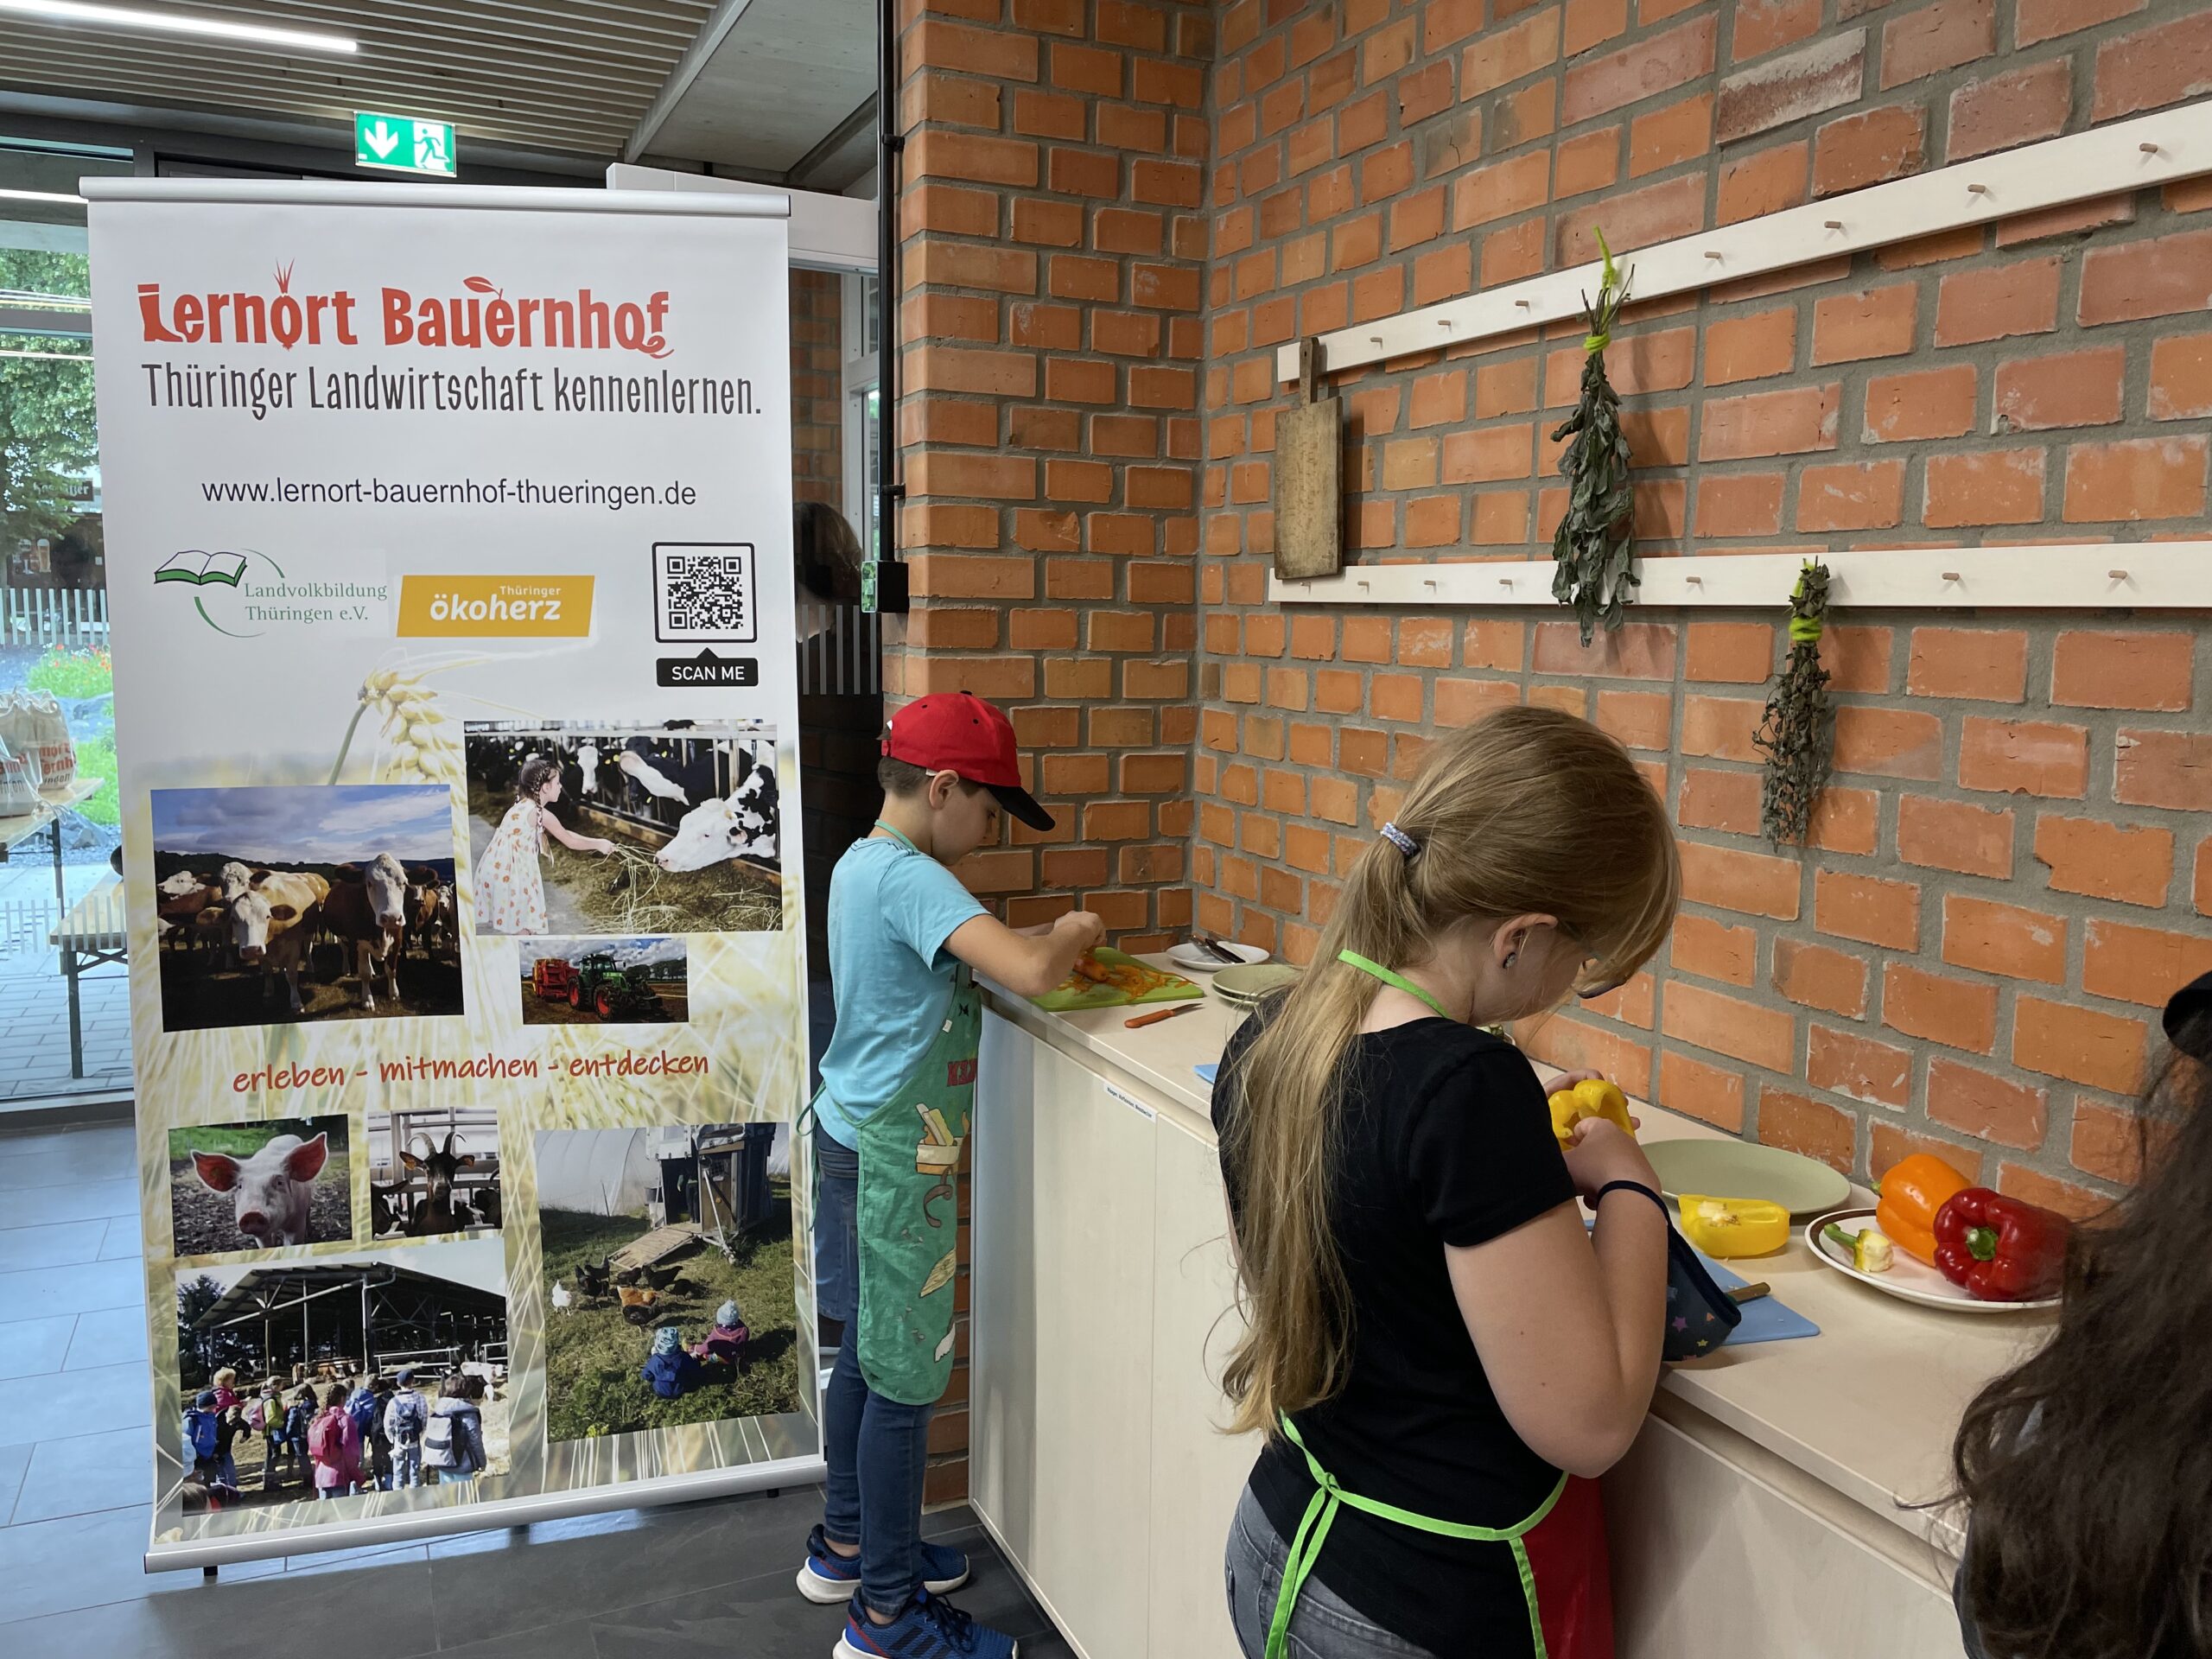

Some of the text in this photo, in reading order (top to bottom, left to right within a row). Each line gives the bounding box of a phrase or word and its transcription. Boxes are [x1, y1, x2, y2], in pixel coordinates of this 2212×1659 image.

[137, 283, 674, 359] Lernort Bauernhof
[141, 362, 761, 421] Thüringer Landwirtschaft kennenlernen.
[201, 477, 696, 511] www.lernort-bauernhof-thueringen.de
[245, 582, 388, 601] Landvolkbildung
[499, 585, 562, 598] Thüringer
[245, 606, 368, 624] Thüringen e.V.
[429, 593, 563, 621] ökoherz
[671, 665, 745, 681] SCAN ME
[232, 1061, 345, 1092] erleben
[379, 1052, 537, 1084] mitmachen
[569, 1050, 709, 1077] entdecken
